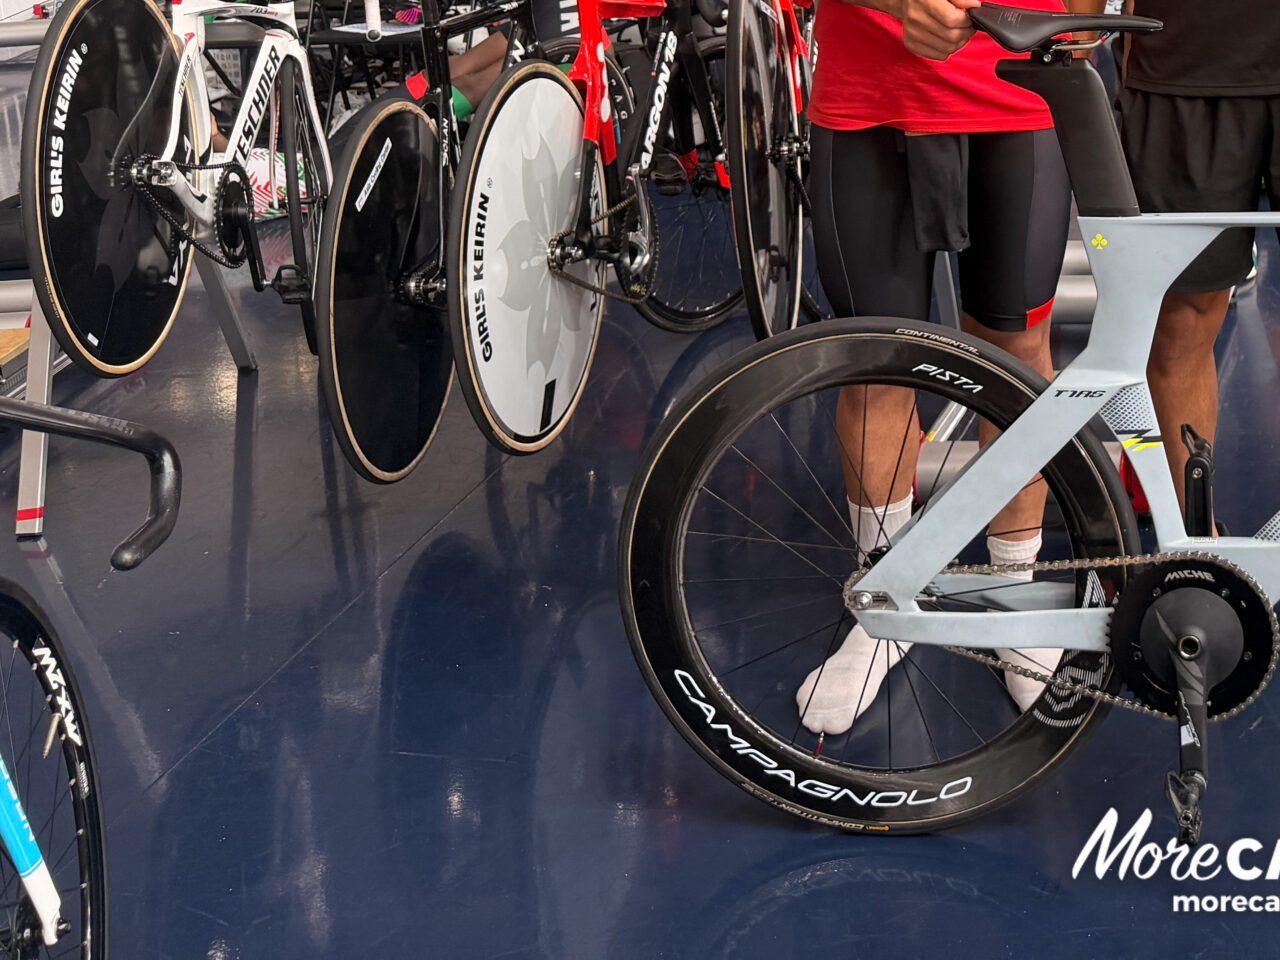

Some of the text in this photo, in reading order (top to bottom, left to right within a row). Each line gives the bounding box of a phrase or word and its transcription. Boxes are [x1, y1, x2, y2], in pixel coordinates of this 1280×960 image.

[50, 49, 84, 218] GIRL'S KEIRIN
[233, 44, 281, 166] TESCHNER
[473, 191, 493, 363] GIRL'S KEIRIN
[895, 328, 980, 356] CONTINENTAL
[912, 363, 984, 394] PISTA
[1164, 570, 1215, 583] MICHE
[673, 669, 973, 807] CAMPAGNOLO
[779, 802, 865, 830] COMPETITION
